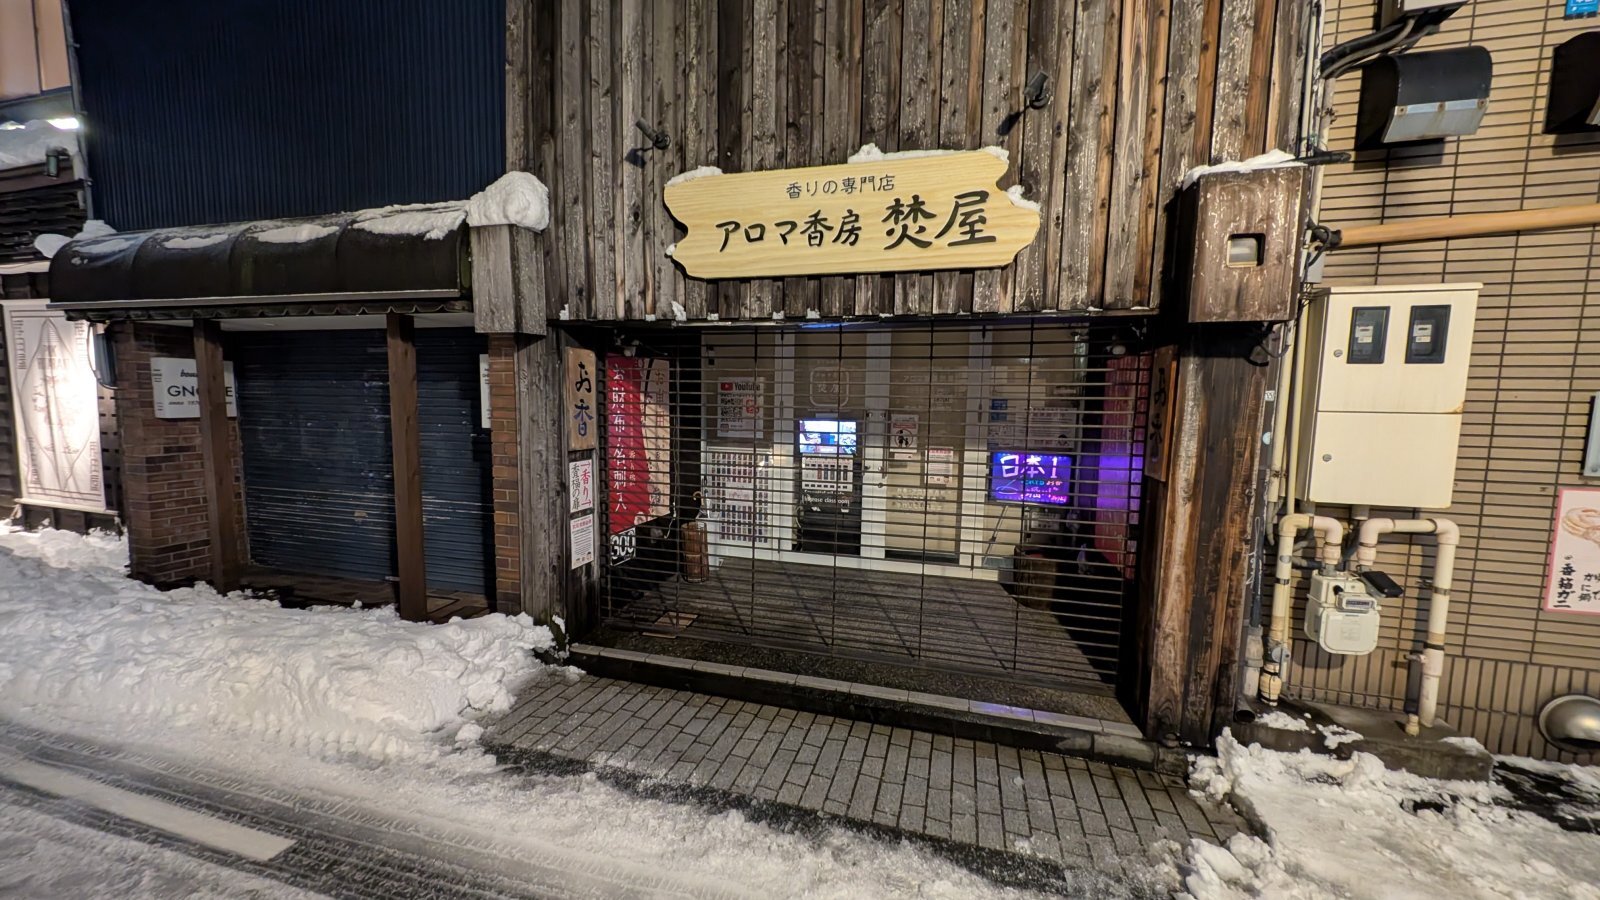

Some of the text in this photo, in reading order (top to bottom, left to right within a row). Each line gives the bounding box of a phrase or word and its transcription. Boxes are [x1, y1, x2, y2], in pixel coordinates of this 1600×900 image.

[786, 174, 896, 200] 香りの専門店
[715, 190, 998, 252] アロマ香房 焚屋
[573, 361, 594, 437] お香
[581, 468, 591, 501] 香り
